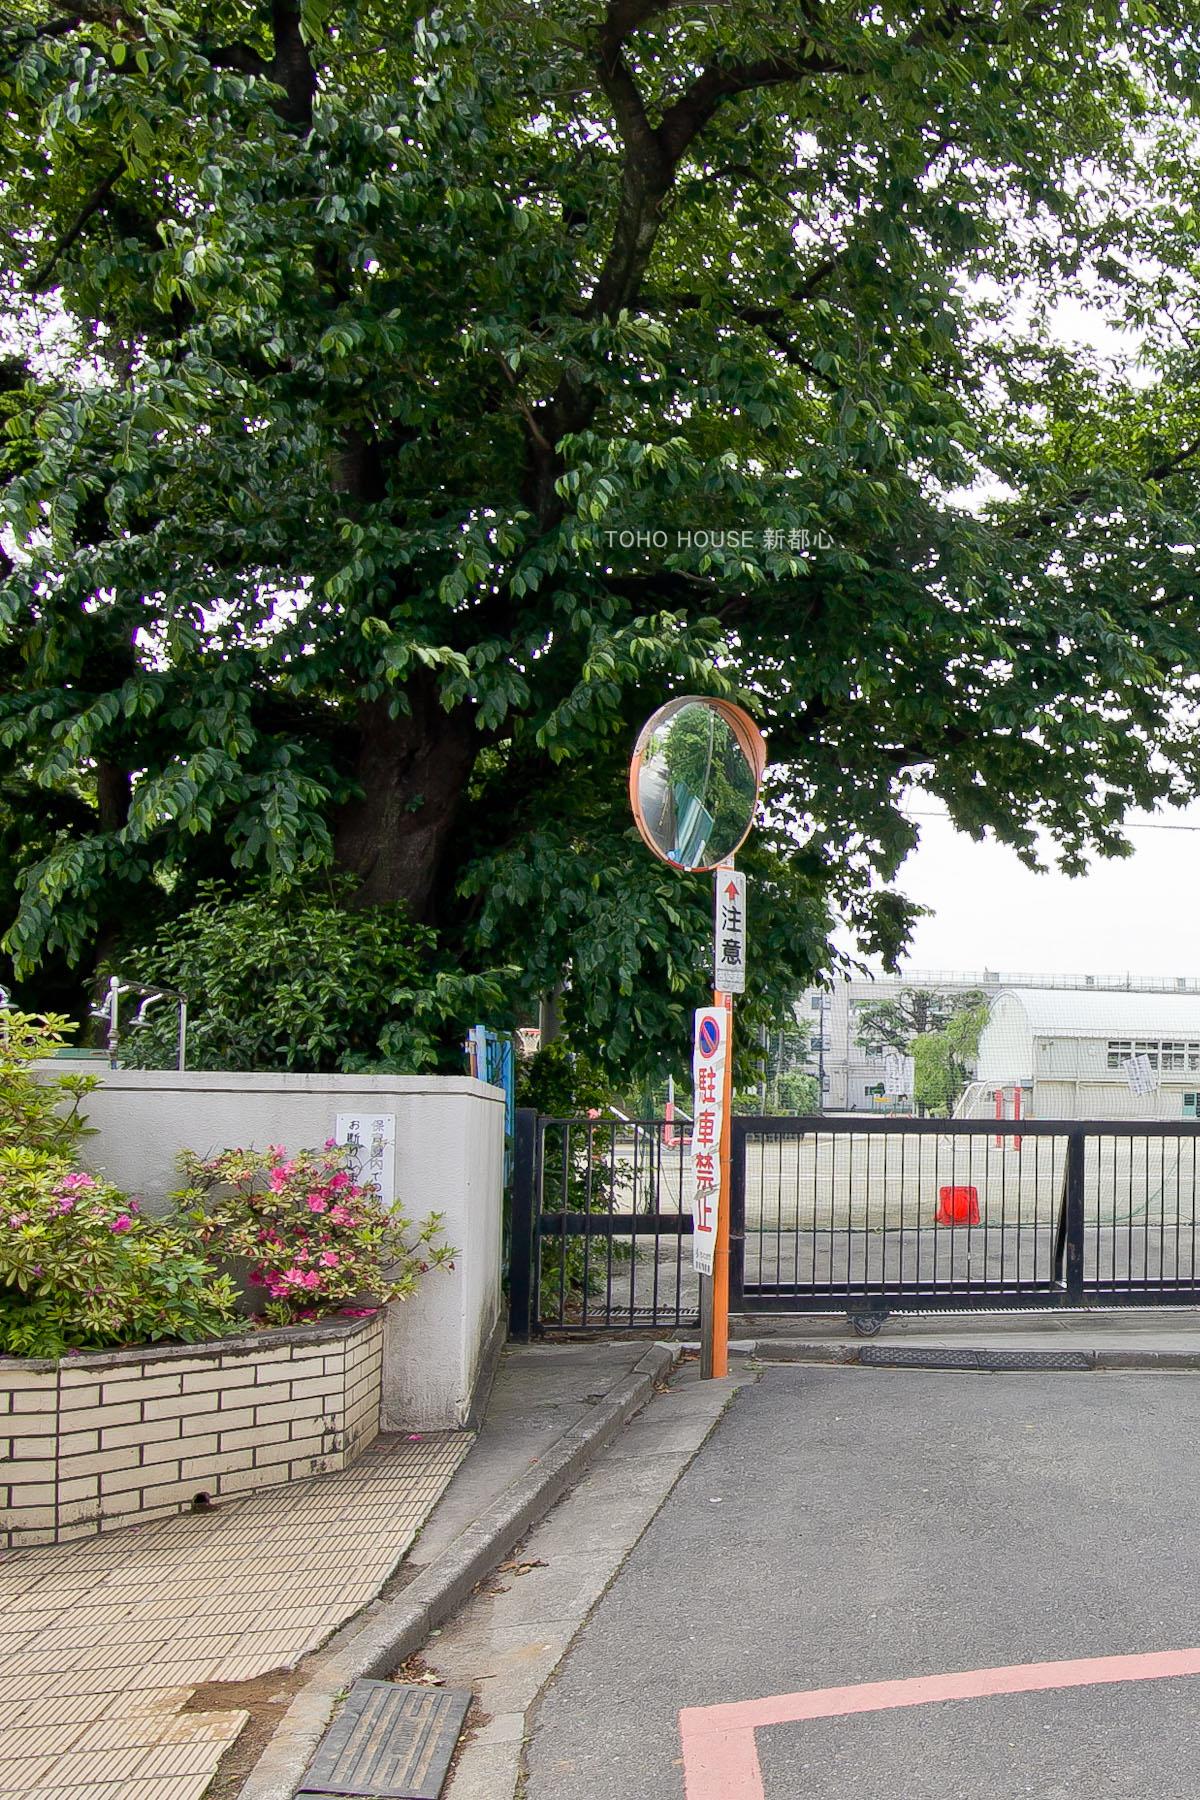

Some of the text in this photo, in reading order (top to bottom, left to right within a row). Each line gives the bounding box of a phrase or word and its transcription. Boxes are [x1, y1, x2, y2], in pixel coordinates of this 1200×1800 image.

[721, 905, 742, 965] 注意
[695, 1066, 716, 1233] 駐車禁止
